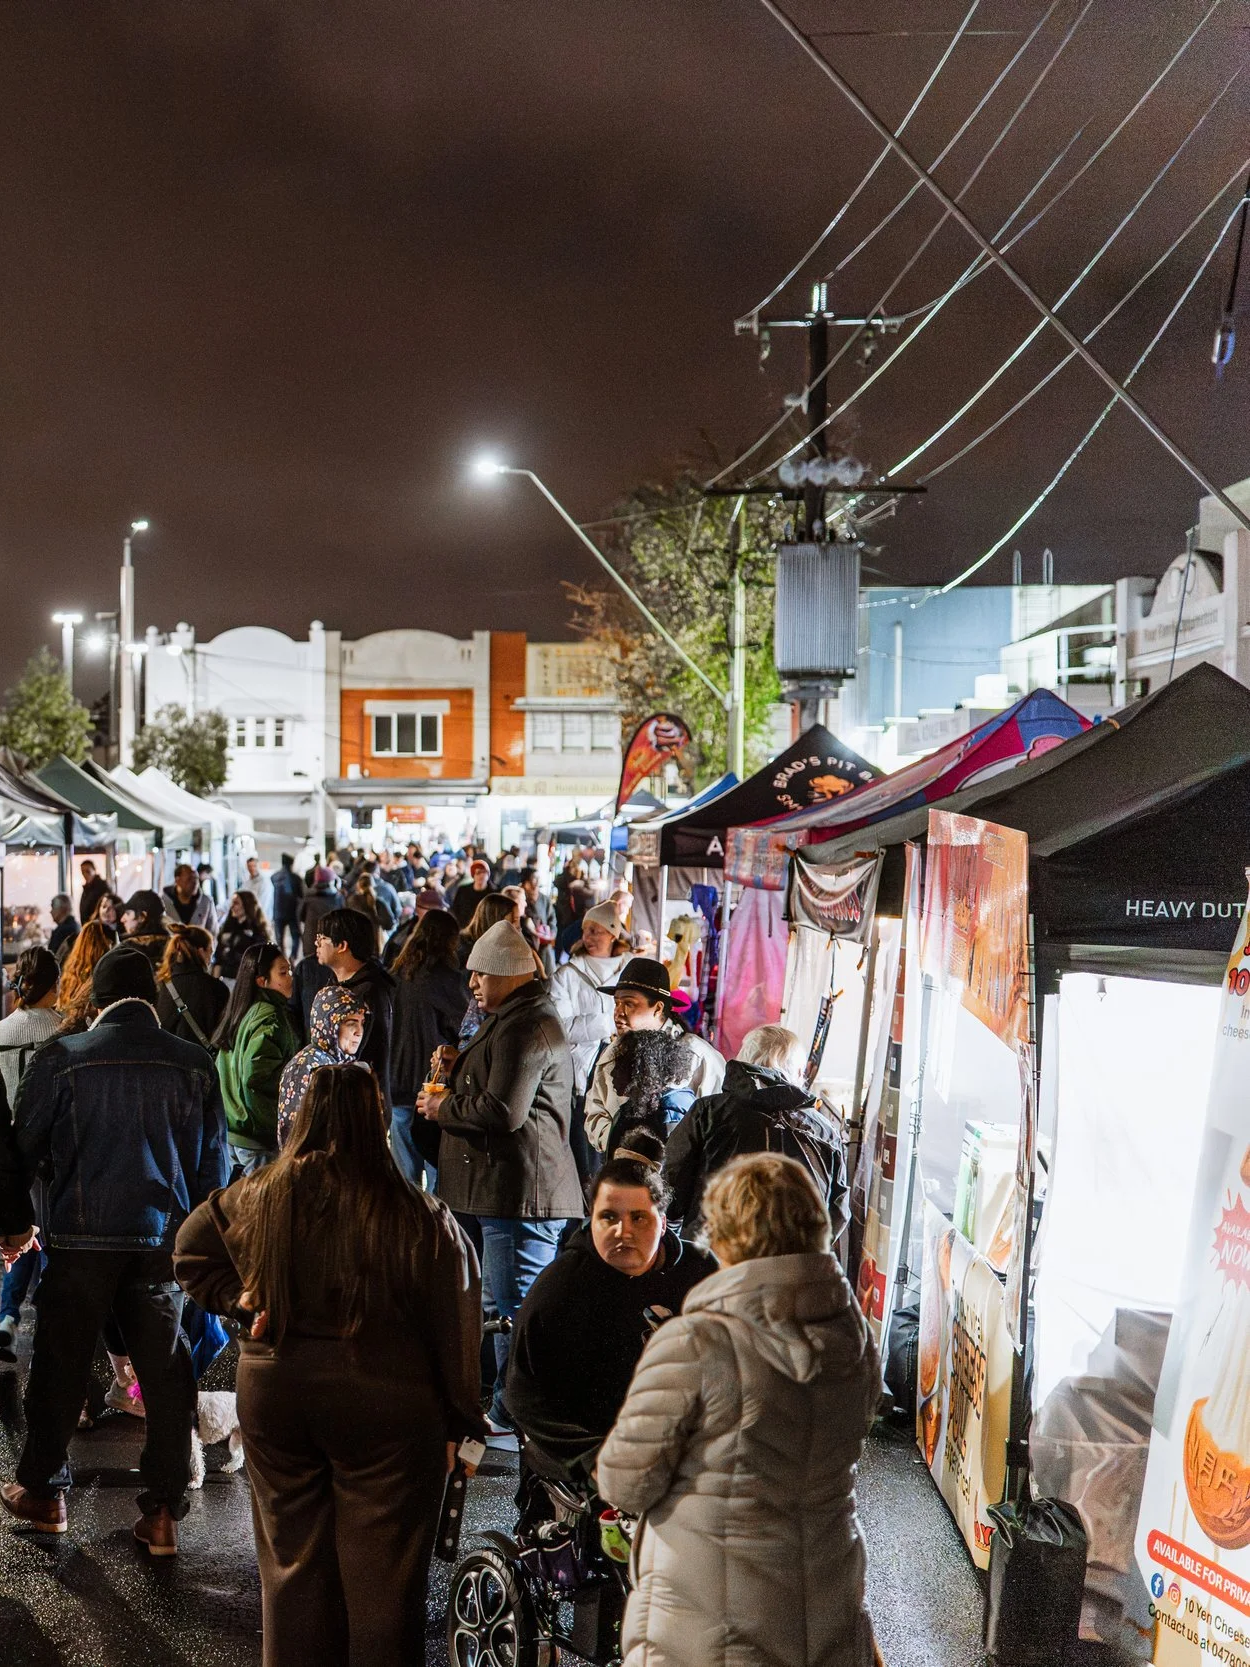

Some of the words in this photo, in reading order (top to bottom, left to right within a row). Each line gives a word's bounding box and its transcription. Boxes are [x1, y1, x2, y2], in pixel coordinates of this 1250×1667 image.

[772, 755, 821, 789] BRAD'S
[827, 756, 857, 771] PIT
[1125, 899, 1196, 919] HEAVY
[1202, 902, 1246, 918] DUT
[1228, 967, 1250, 997] 10
[1222, 1023, 1250, 1039] chees
[1153, 1538, 1202, 1578] AVAILABLE
[1202, 1565, 1223, 1591] FOR
[1223, 1579, 1250, 1607] PRIVA
[1148, 1602, 1186, 1638] Contact
[1186, 1629, 1199, 1646] us
[1200, 1637, 1210, 1653] at
[1184, 1597, 1195, 1614] 10
[1196, 1602, 1213, 1625] Yen
[1214, 1615, 1250, 1649] Cheese
